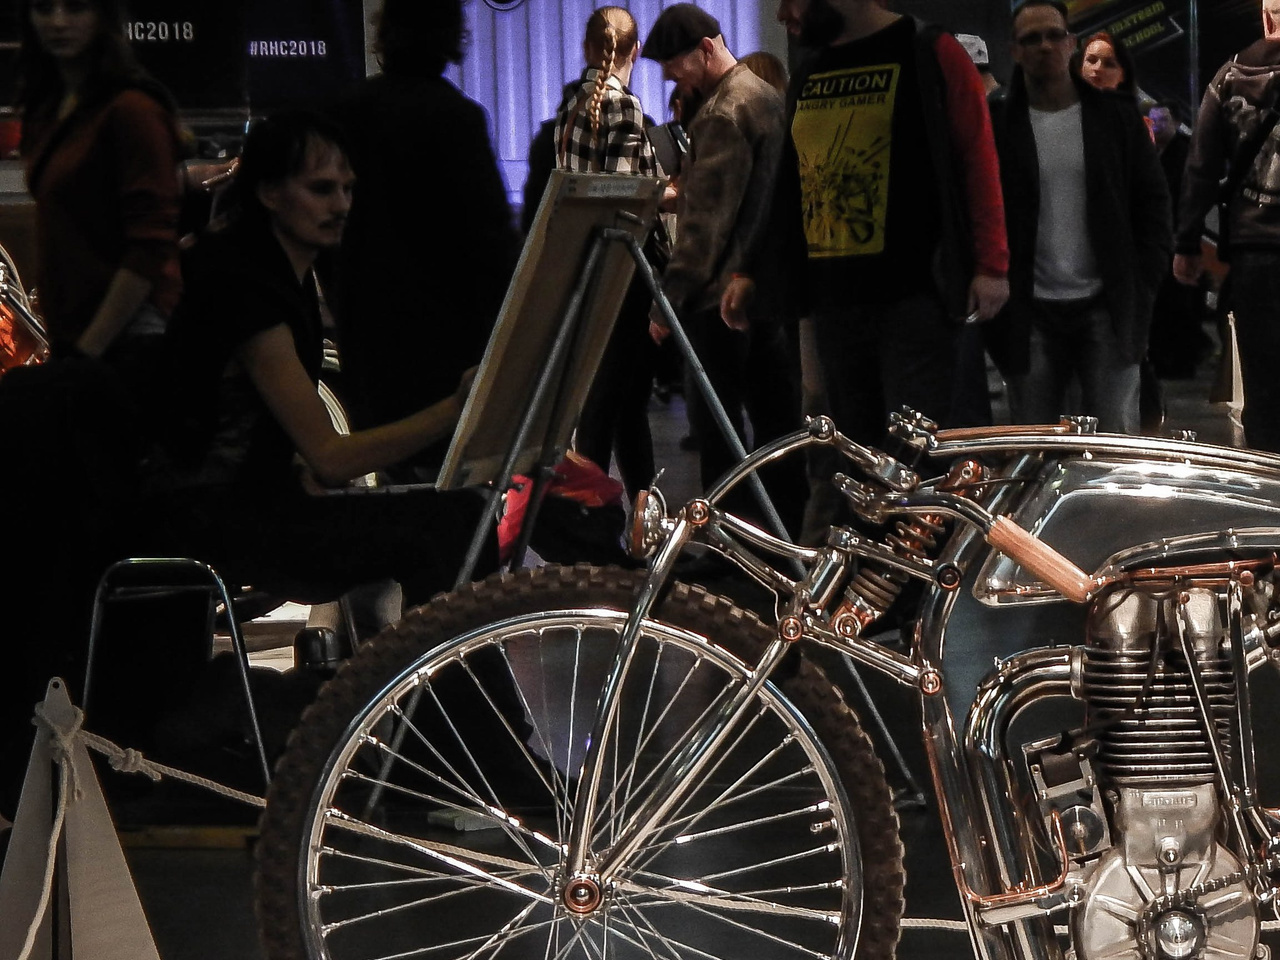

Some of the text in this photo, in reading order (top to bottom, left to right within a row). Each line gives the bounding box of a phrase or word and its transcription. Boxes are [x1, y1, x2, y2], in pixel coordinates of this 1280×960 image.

[250, 40, 327, 56] #RHC2018
[801, 72, 888, 97] CAUTION
[839, 93, 886, 108] GAMER
